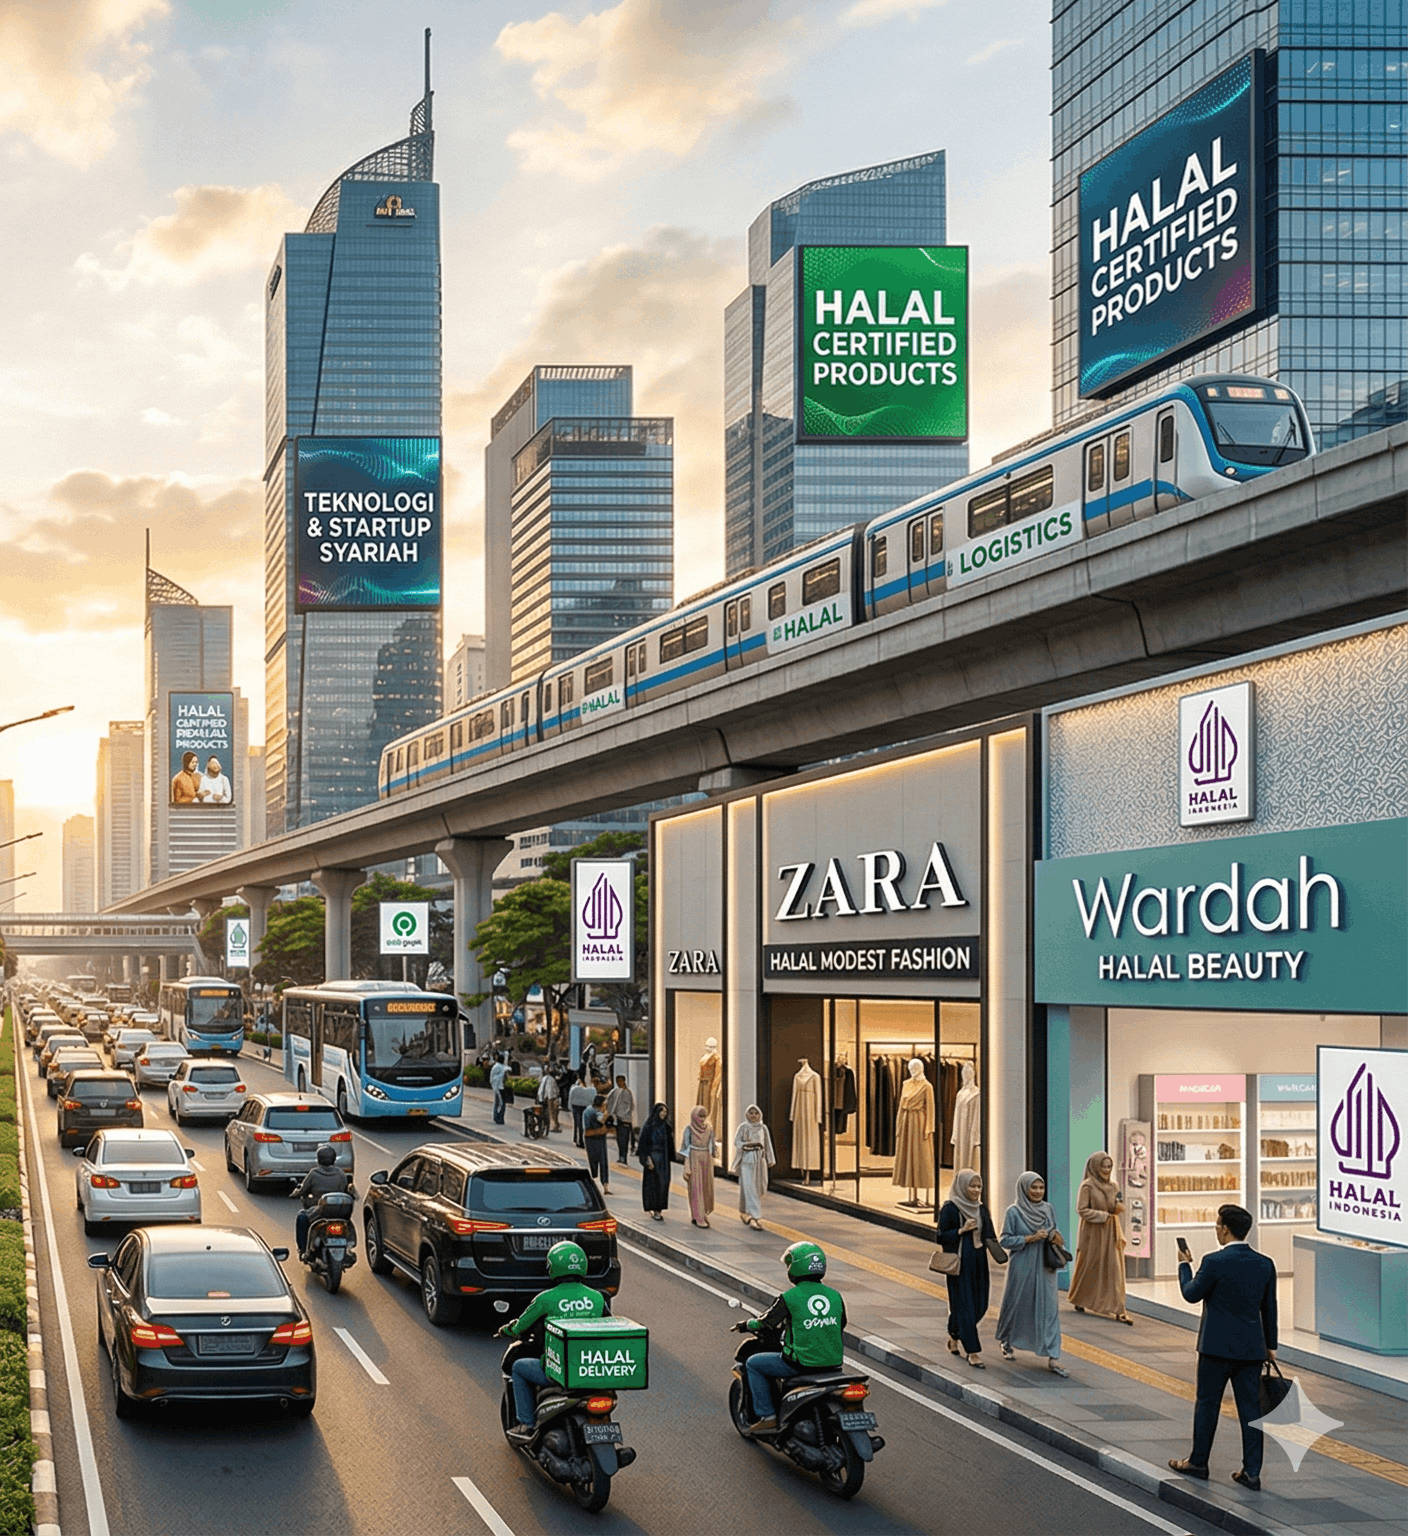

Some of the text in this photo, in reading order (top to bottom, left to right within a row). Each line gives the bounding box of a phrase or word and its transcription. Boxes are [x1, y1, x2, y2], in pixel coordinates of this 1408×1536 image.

[1093, 136, 1237, 264] HALAL
[1091, 187, 1238, 298] CERTIFIED
[1092, 226, 1238, 337] PRODUCTS
[816, 290, 955, 325] HALAL
[813, 331, 957, 356] CERTIFIED
[814, 362, 957, 386] PRODUCTS
[304, 492, 434, 513] TEKNOLOGI
[307, 517, 431, 537] & STARTUP
[319, 542, 418, 563] SYARIAH
[960, 512, 1072, 574] LOGISTICS
[784, 602, 843, 642] HALAL
[178, 705, 225, 717] HALAL
[1189, 787, 1238, 806] HALAL
[774, 841, 969, 922] ZARA
[1072, 855, 1340, 939] Wardah
[582, 944, 624, 954] HALAL
[770, 946, 970, 971] HALAL MODEST FASHION
[668, 950, 719, 974] ZARA
[1098, 950, 1305, 980] HALAL BEAUTY
[1329, 1180, 1401, 1209] HALAL
[1329, 1200, 1402, 1222] INDONESIA
[558, 1297, 594, 1312] Grab
[580, 1349, 635, 1364] HALAL
[579, 1364, 637, 1377] DELIVERY
